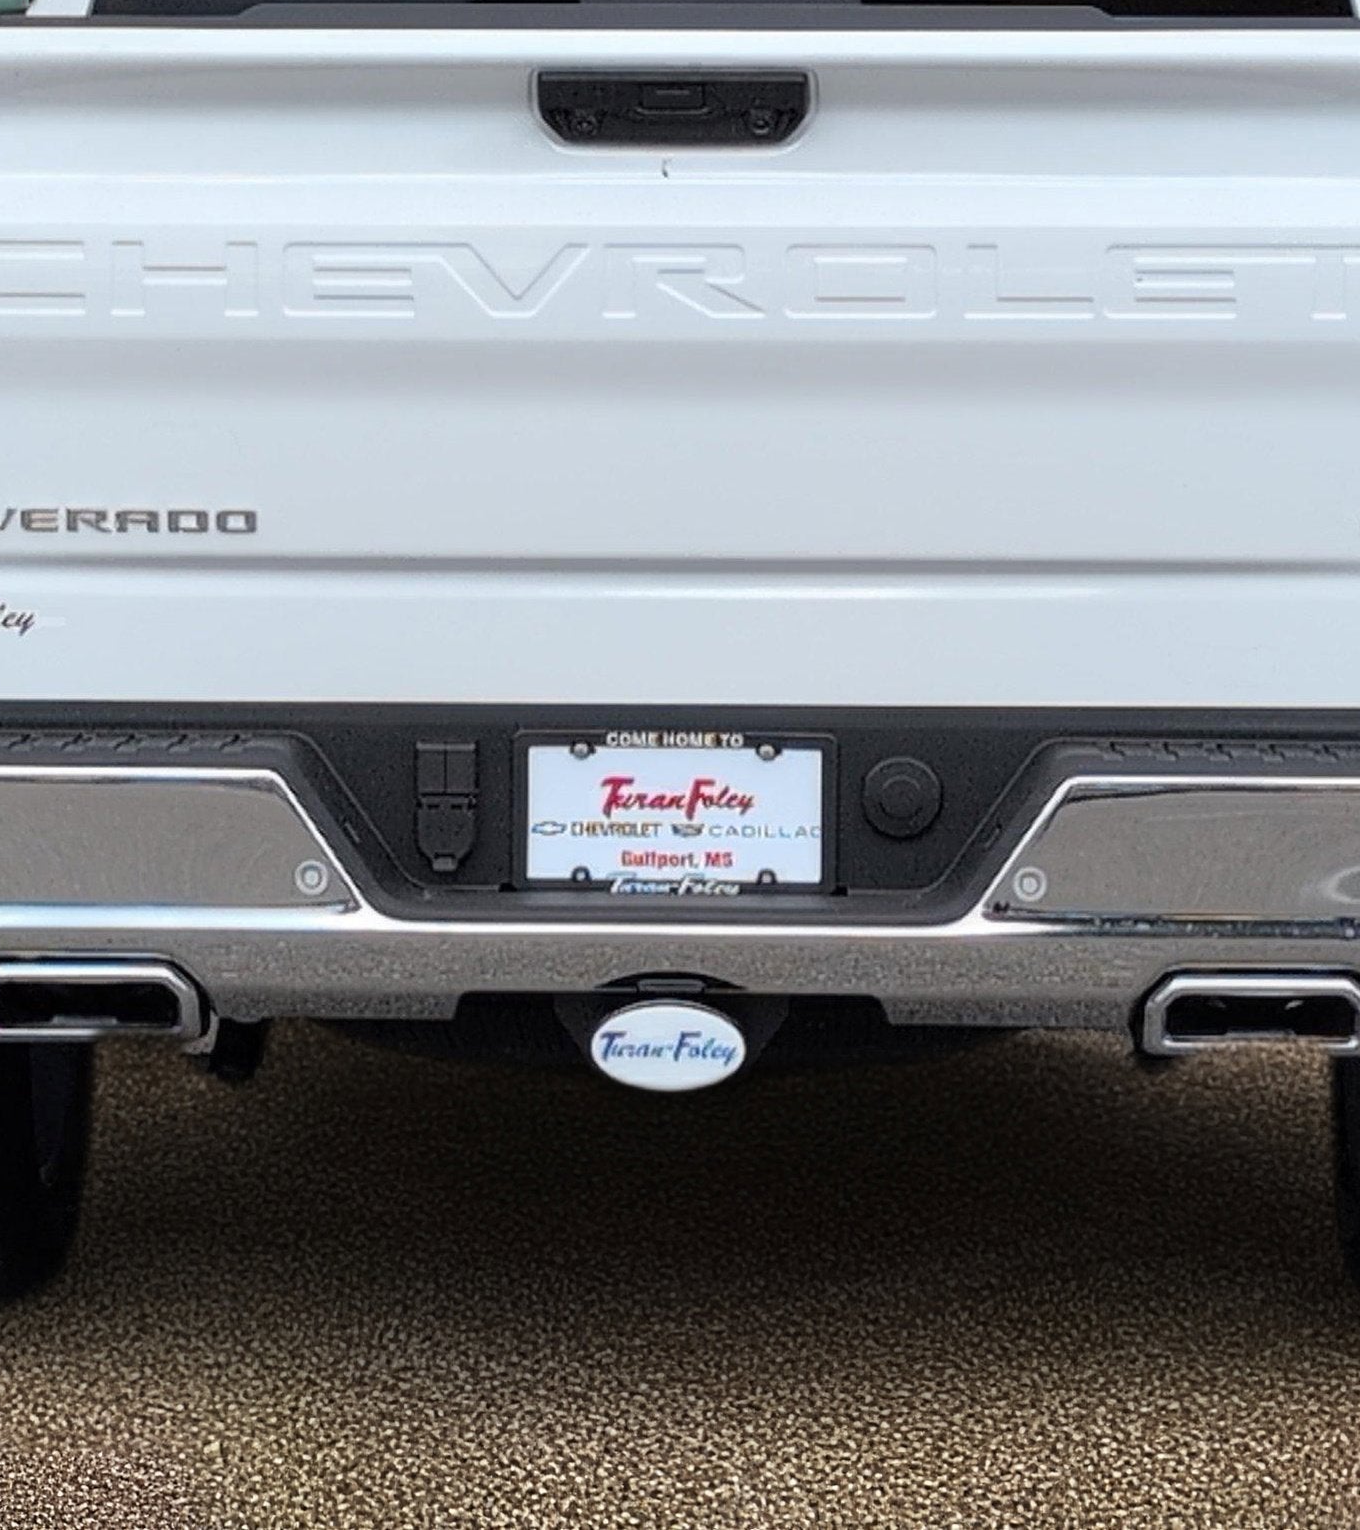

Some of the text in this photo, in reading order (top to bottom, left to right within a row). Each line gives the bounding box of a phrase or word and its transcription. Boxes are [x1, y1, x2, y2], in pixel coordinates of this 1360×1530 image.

[605, 731, 745, 747] COME HOME TO
[569, 822, 822, 839] CHEVROLET CADILLAC
[620, 850, 733, 870] Gulfport, MS
